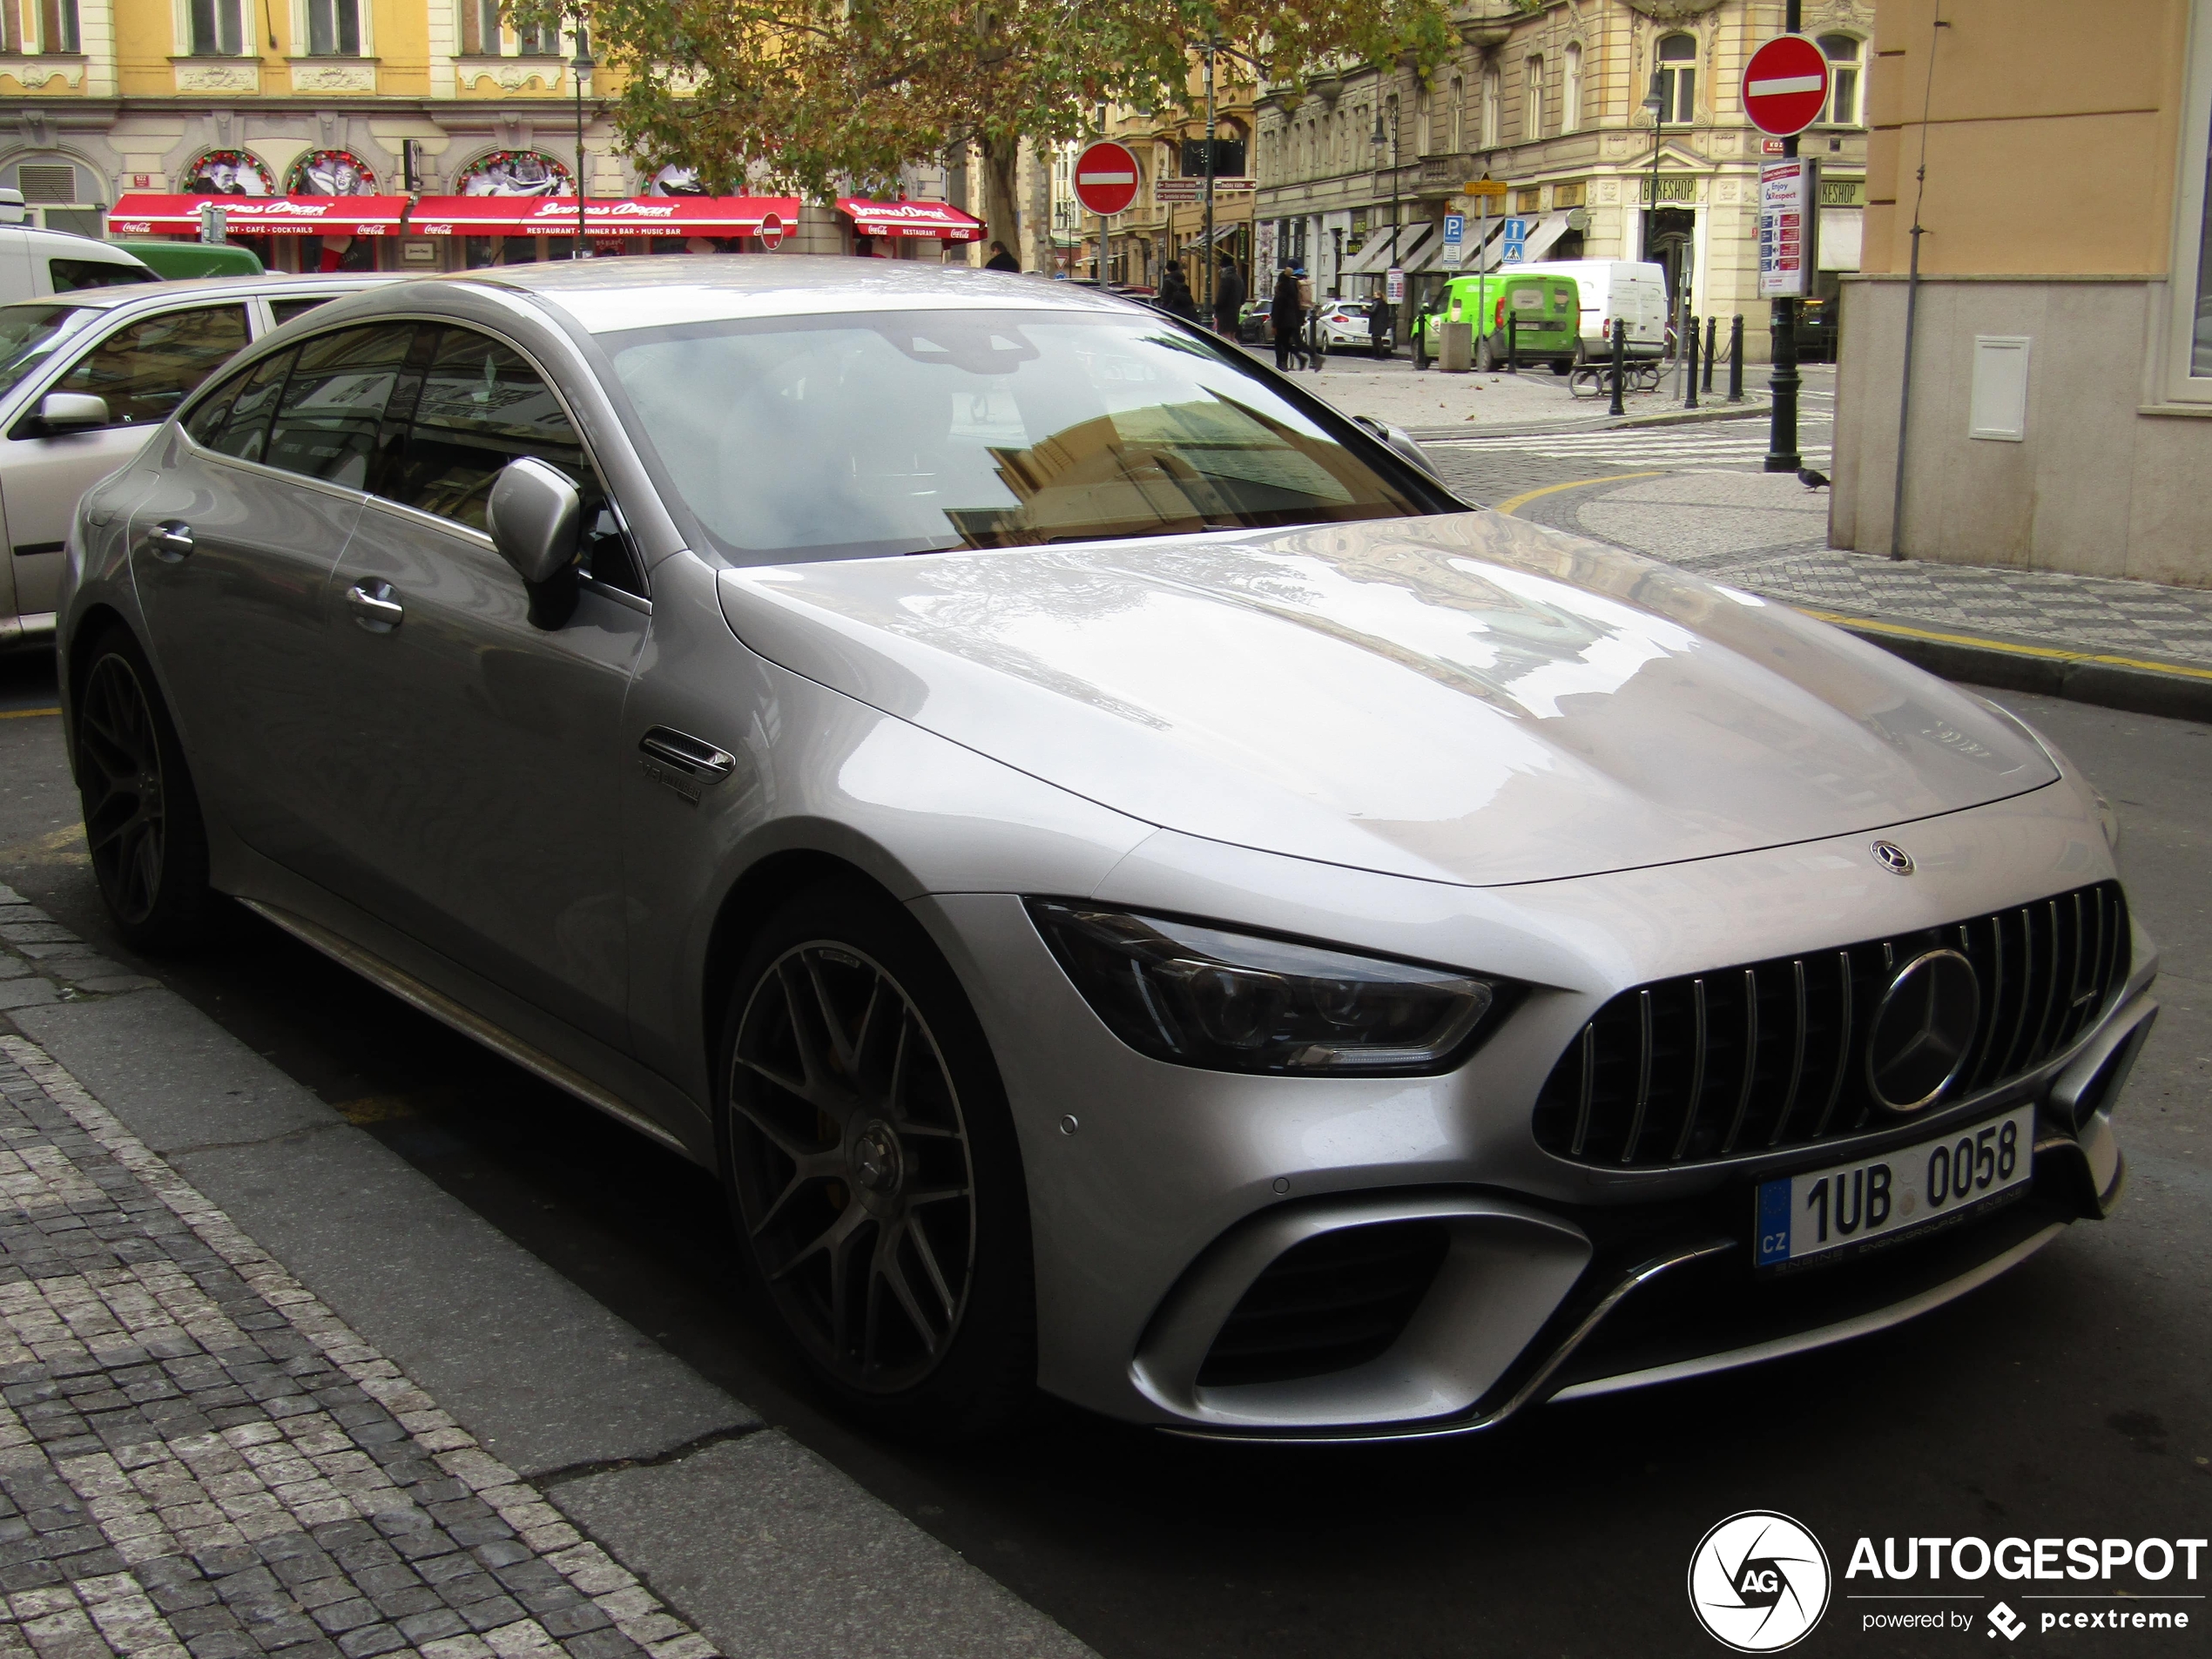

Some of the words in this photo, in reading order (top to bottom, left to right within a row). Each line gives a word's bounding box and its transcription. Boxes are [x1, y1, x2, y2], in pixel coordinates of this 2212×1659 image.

[1771, 182, 1788, 192] Enjoy
[1821, 184, 1856, 203] KESHOP
[1771, 192, 1797, 201] Respect
[265, 201, 327, 214] Dean
[611, 202, 673, 214] Dean
[849, 203, 901, 216] James
[901, 206, 947, 219] Dean
[1447, 219, 1460, 235] P
[1807, 1162, 1892, 1244] 1UB
[1927, 1120, 2017, 1208] 0058
[1763, 1231, 1785, 1254] CZ
